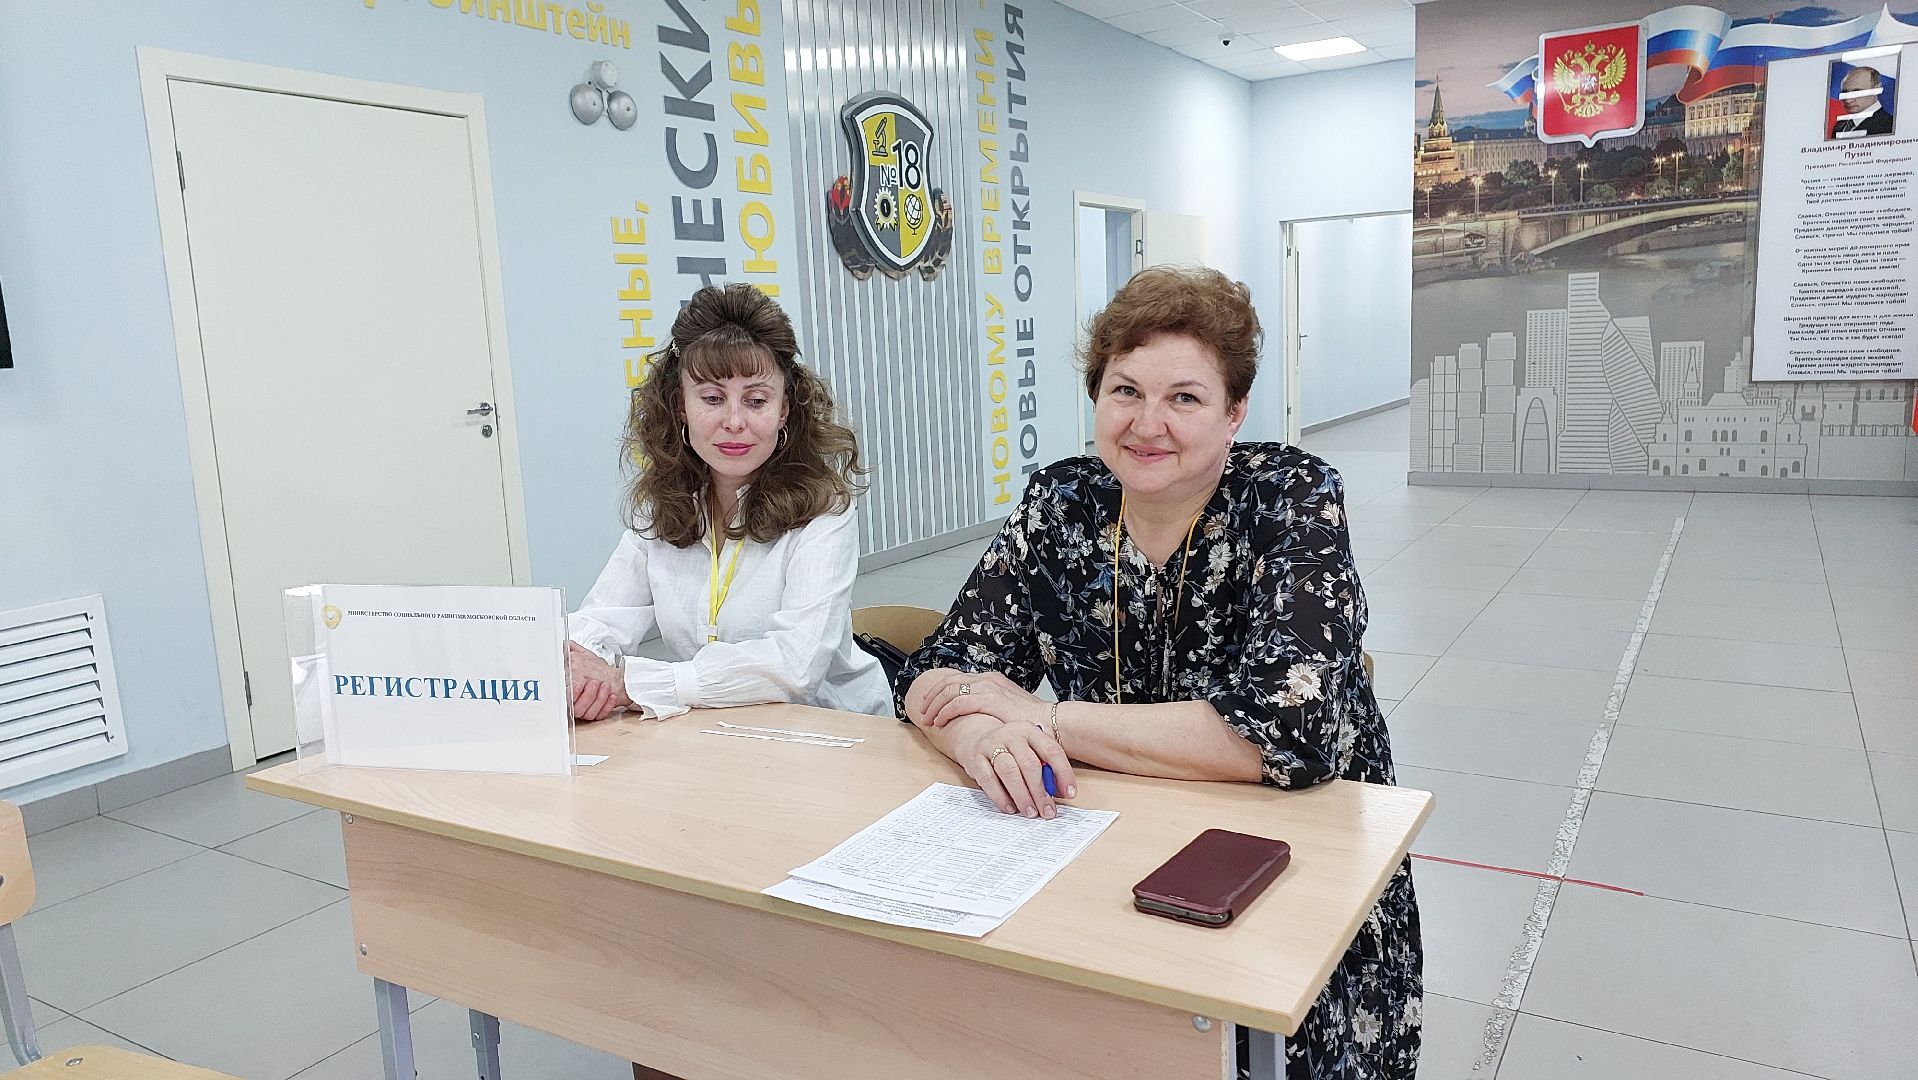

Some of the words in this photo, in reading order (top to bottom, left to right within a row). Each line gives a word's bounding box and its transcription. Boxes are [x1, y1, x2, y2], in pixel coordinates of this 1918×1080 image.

[892, 140, 921, 190] 18
[974, 27, 1003, 275] ВРЕМЕНИ
[1004, 3, 1032, 302] ОТКРЫТИЯ
[1801, 143, 1846, 153] Владимир
[1838, 159, 1873, 167] Российской
[1875, 155, 1911, 165] Федерации
[1845, 150, 1872, 160] Путин
[983, 293, 1011, 505] НОВОМУ
[333, 674, 542, 706] РЕГИСТРАЦИЯ
